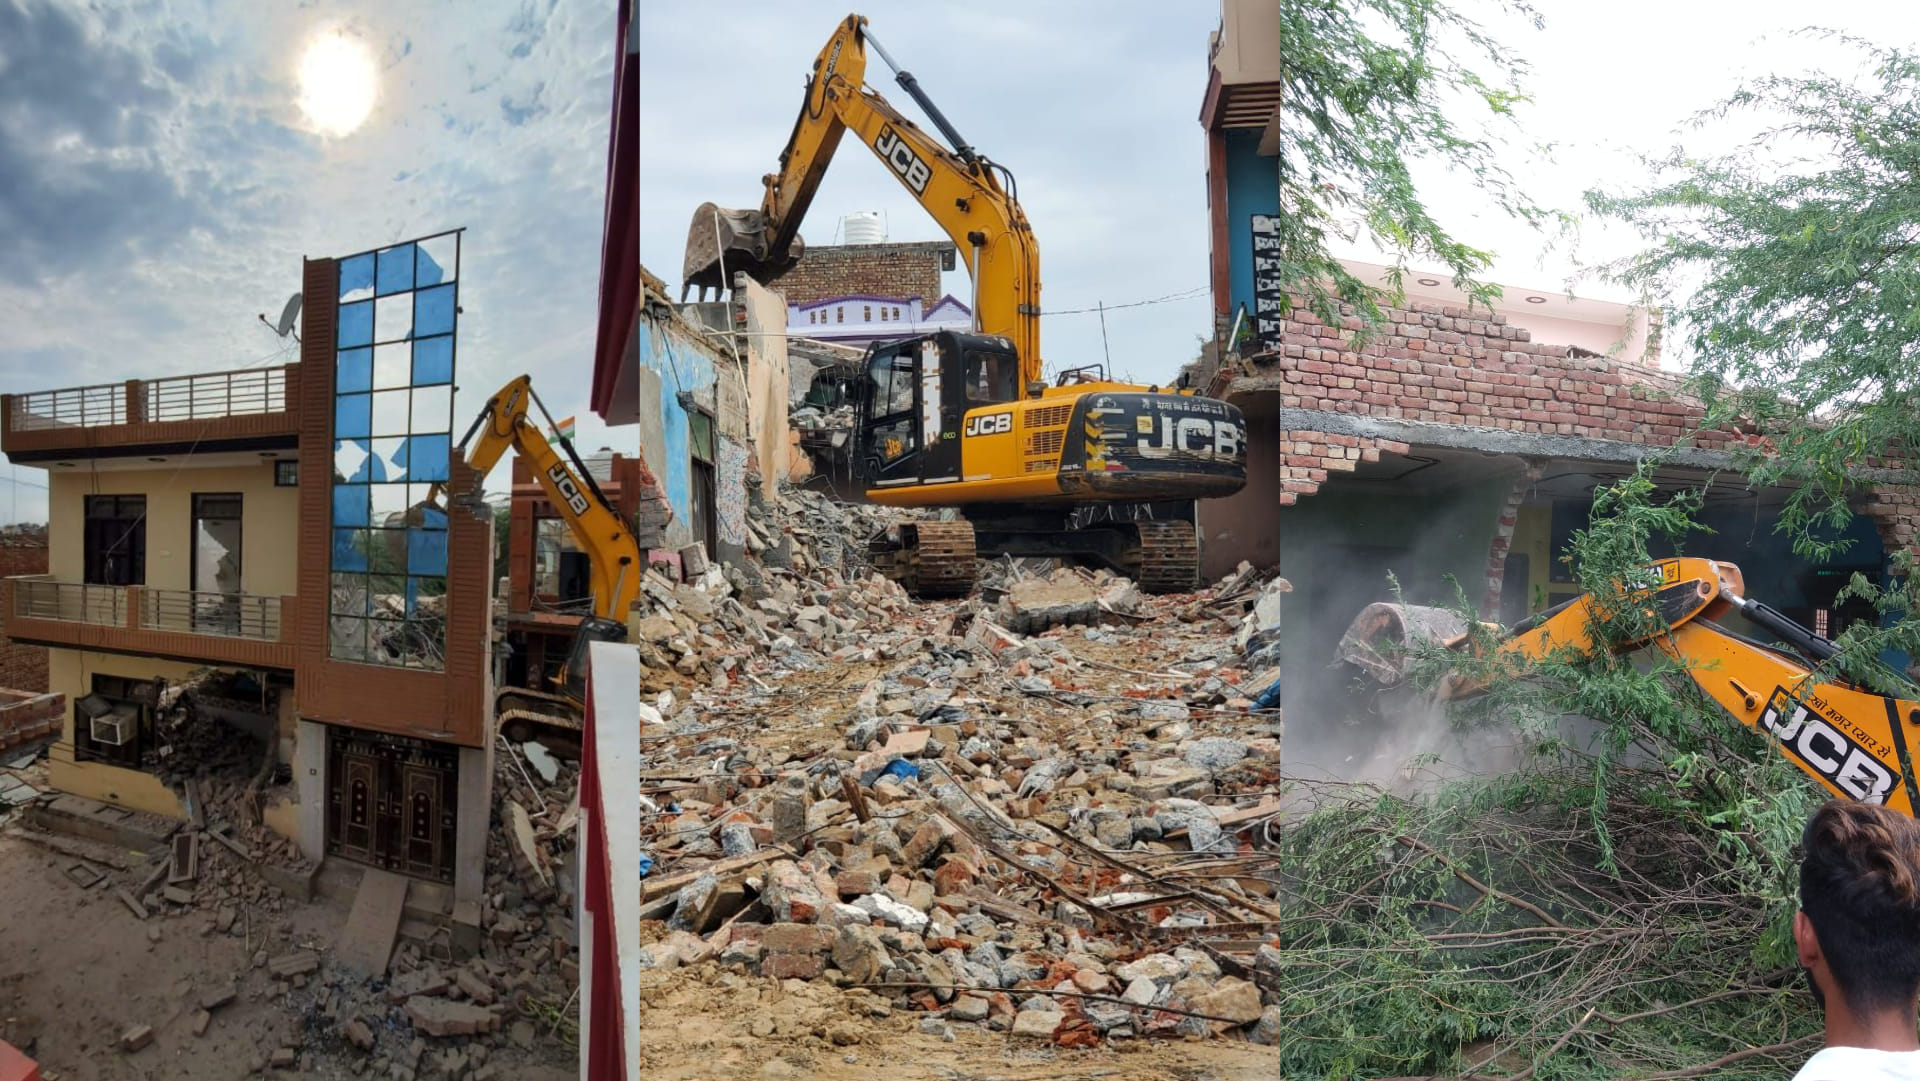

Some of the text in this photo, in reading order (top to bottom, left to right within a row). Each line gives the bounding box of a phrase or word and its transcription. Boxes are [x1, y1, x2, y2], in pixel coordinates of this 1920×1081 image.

[877, 134, 930, 192] JCB
[967, 413, 1012, 436] JCB
[1137, 416, 1239, 462] JCB
[549, 468, 588, 514] JCB
[1764, 705, 1892, 805] JCB
[1825, 708, 1854, 730] मगर
[1851, 726, 1878, 749] प्यार
[1876, 744, 1891, 758] से
